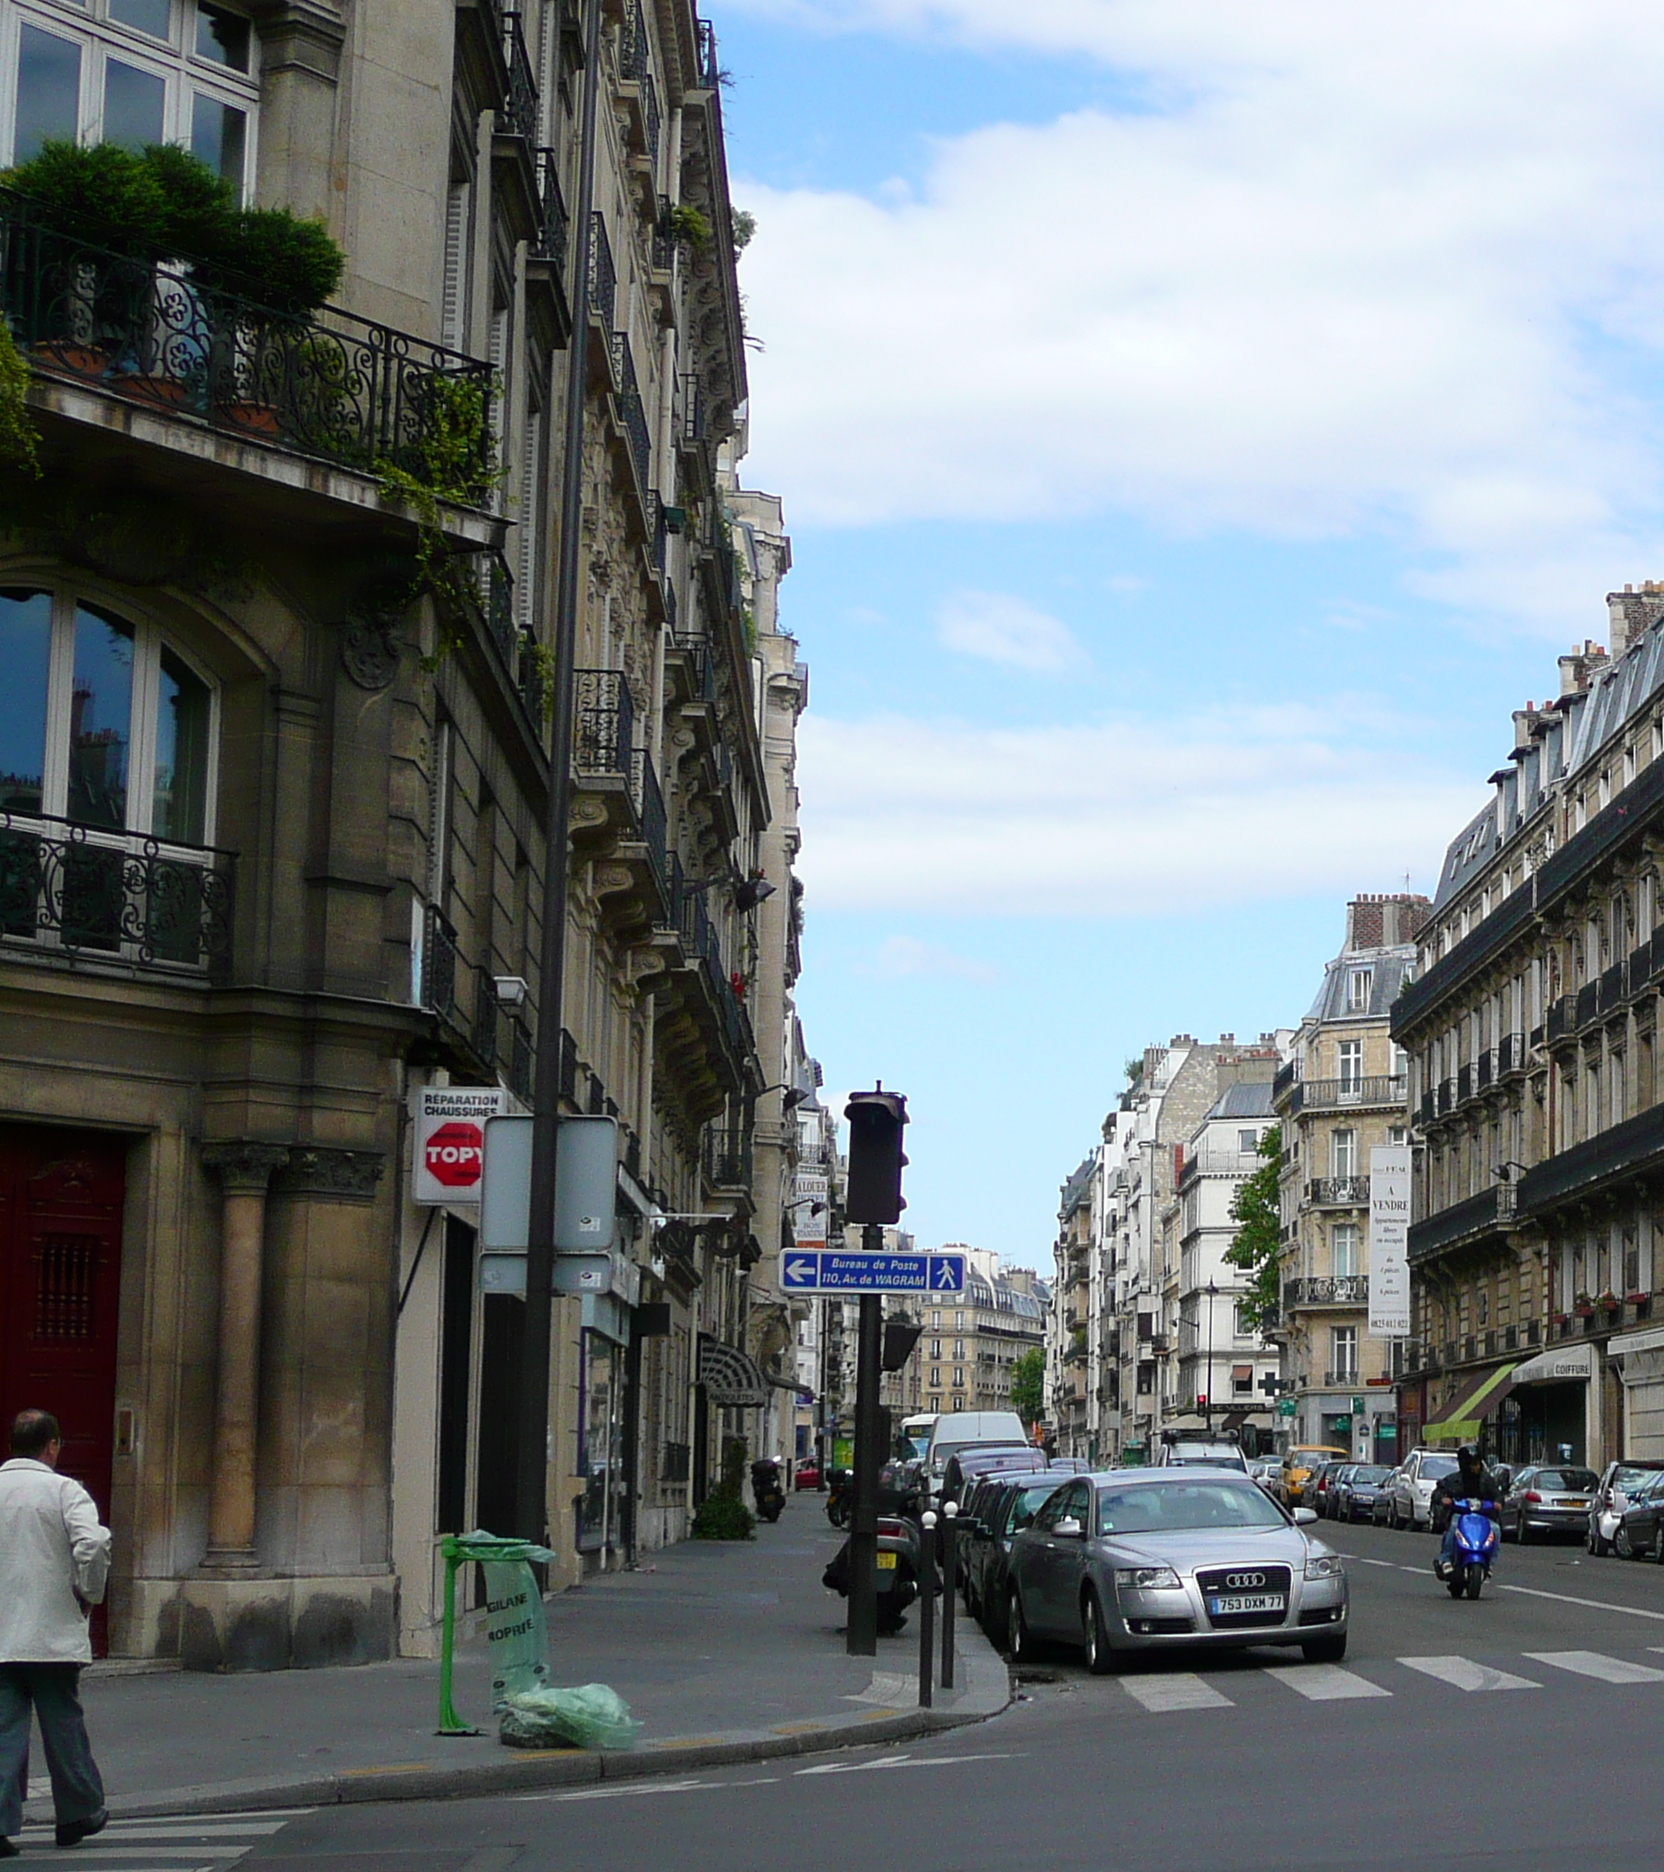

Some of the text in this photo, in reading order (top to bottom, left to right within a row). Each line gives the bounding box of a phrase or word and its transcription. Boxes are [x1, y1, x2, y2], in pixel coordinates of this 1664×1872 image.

[425, 1093, 498, 1105] RÉPARATION
[425, 1106, 497, 1116] CHAUSSURES
[1387, 1186, 1394, 1196] A
[1373, 1200, 1409, 1211] VENDRE
[832, 1258, 919, 1270] Bureau de Poste
[822, 1273, 841, 1285] 110,
[860, 1274, 872, 1284] de
[875, 1275, 925, 1286] WAGRAM
[1556, 1364, 1590, 1375] COIFFURE
[1221, 1596, 1282, 1611] 753 DXM 77
